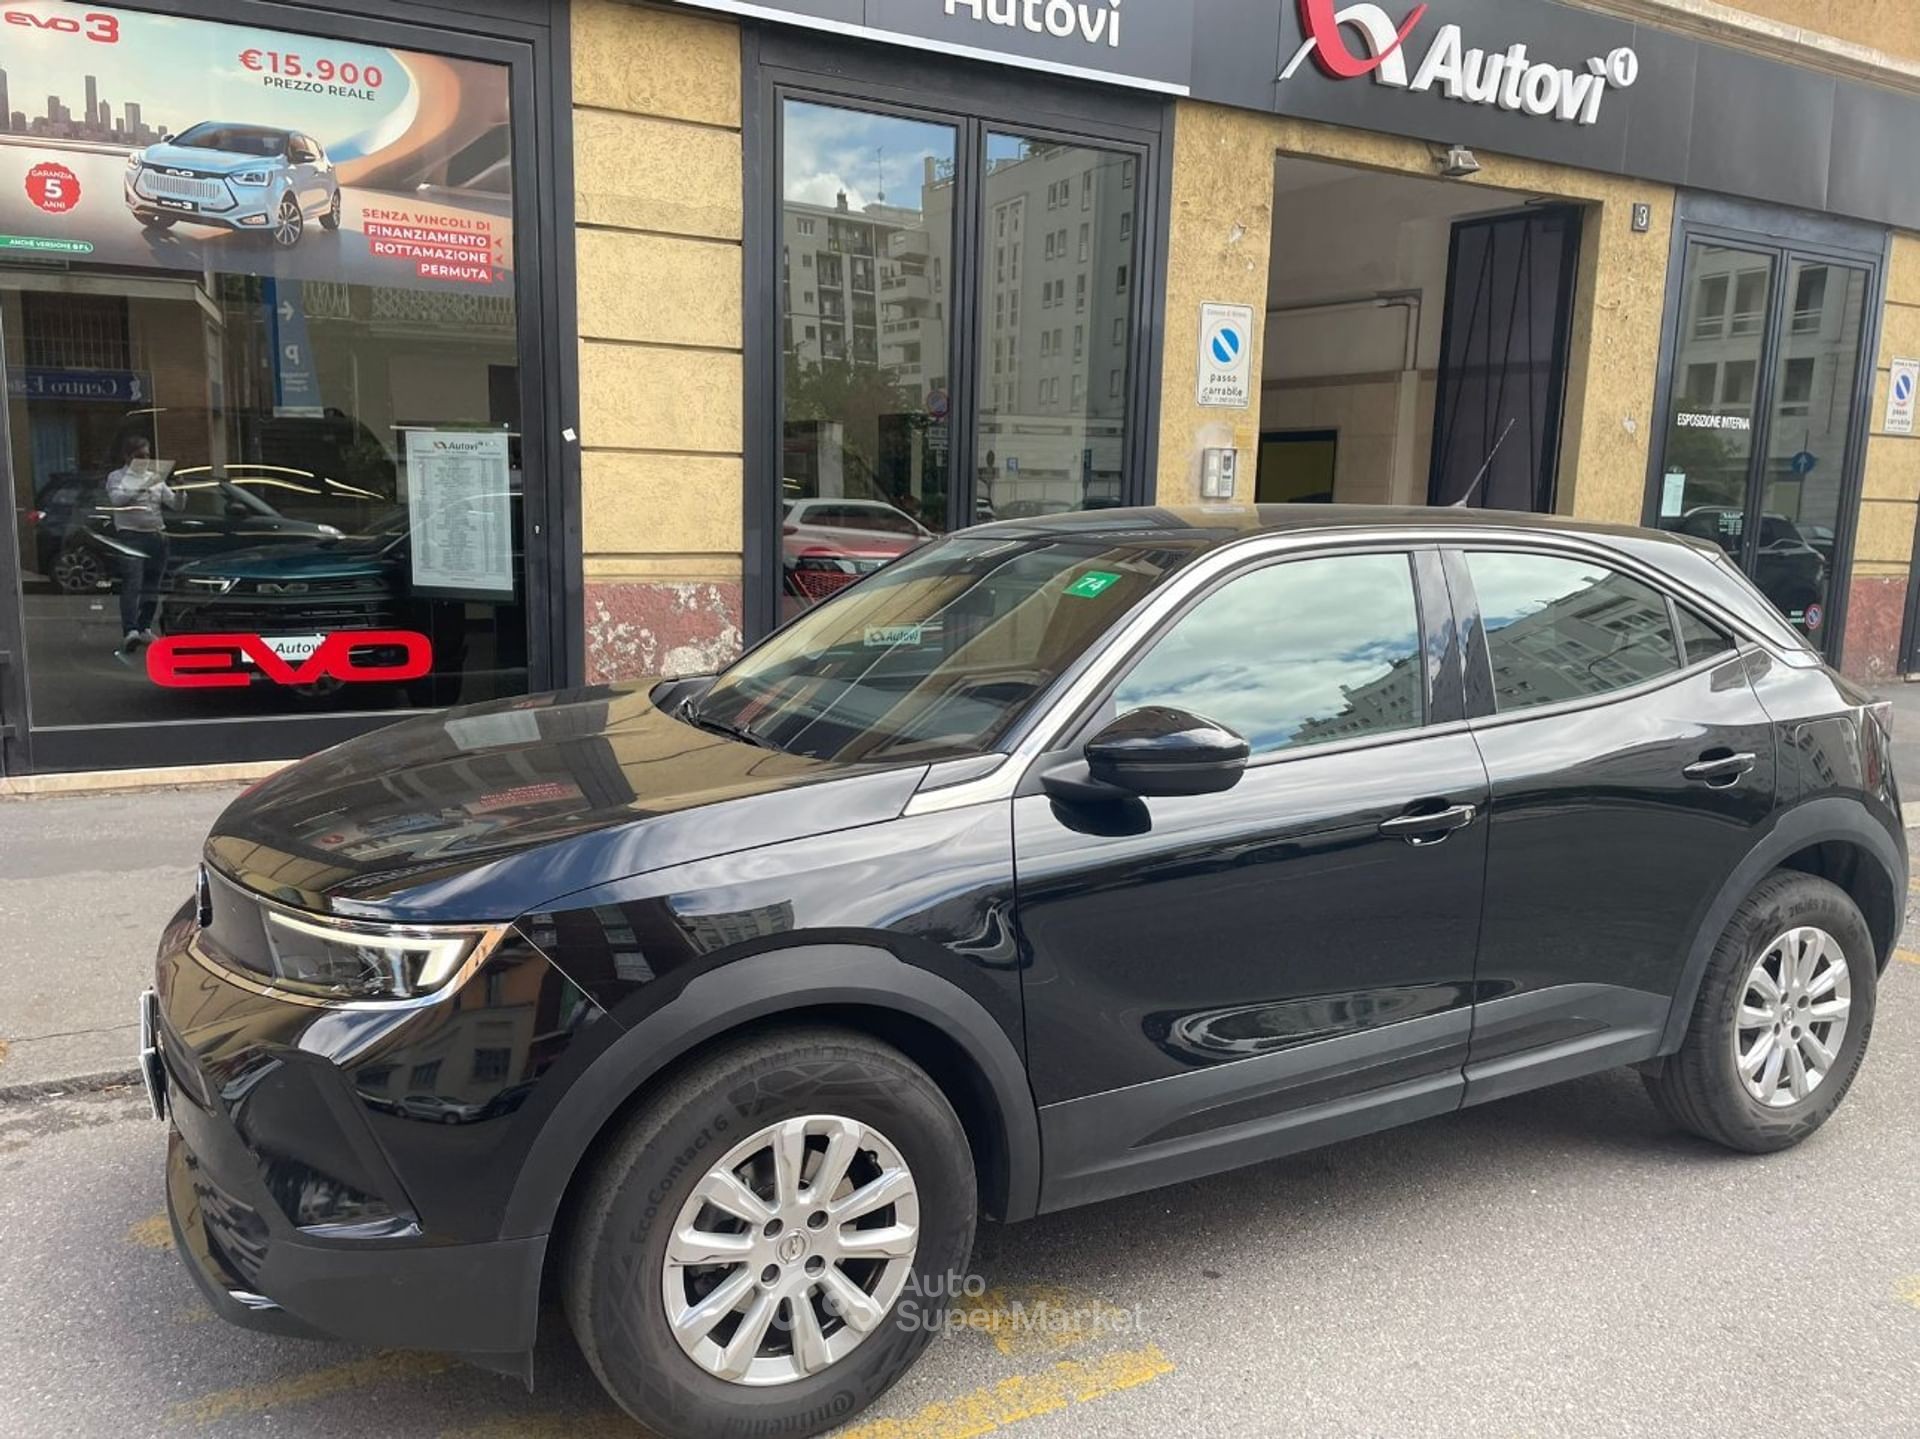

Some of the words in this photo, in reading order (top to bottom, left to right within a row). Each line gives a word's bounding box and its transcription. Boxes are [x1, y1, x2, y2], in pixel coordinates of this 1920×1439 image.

[4, 11, 80, 32] EVO
[85, 13, 119, 43] 3
[238, 49, 383, 88] €15.900
[263, 76, 324, 94] PREZZO
[328, 85, 376, 101] REALE
[31, 169, 73, 180] GARANZIA
[44, 178, 63, 199] 5
[43, 200, 66, 209] ANNI
[362, 208, 410, 223] SENZA
[415, 214, 472, 229] VINCOLI
[476, 221, 490, 231] DI
[1638, 206, 1648, 227] 3
[367, 224, 487, 247] FINANZIAMENTO
[375, 242, 488, 264] ROTTAMAZIONE
[421, 263, 488, 280] PERMUTA
[1210, 373, 1238, 384] passo
[1202, 386, 1243, 397] carrabile
[1677, 412, 1721, 429] ESPOSIZIONE
[1721, 416, 1751, 431] INTERNA
[145, 630, 433, 687] EVO
[630, 1127, 714, 1245] EcoContact
[713, 1113, 729, 1132] 6
